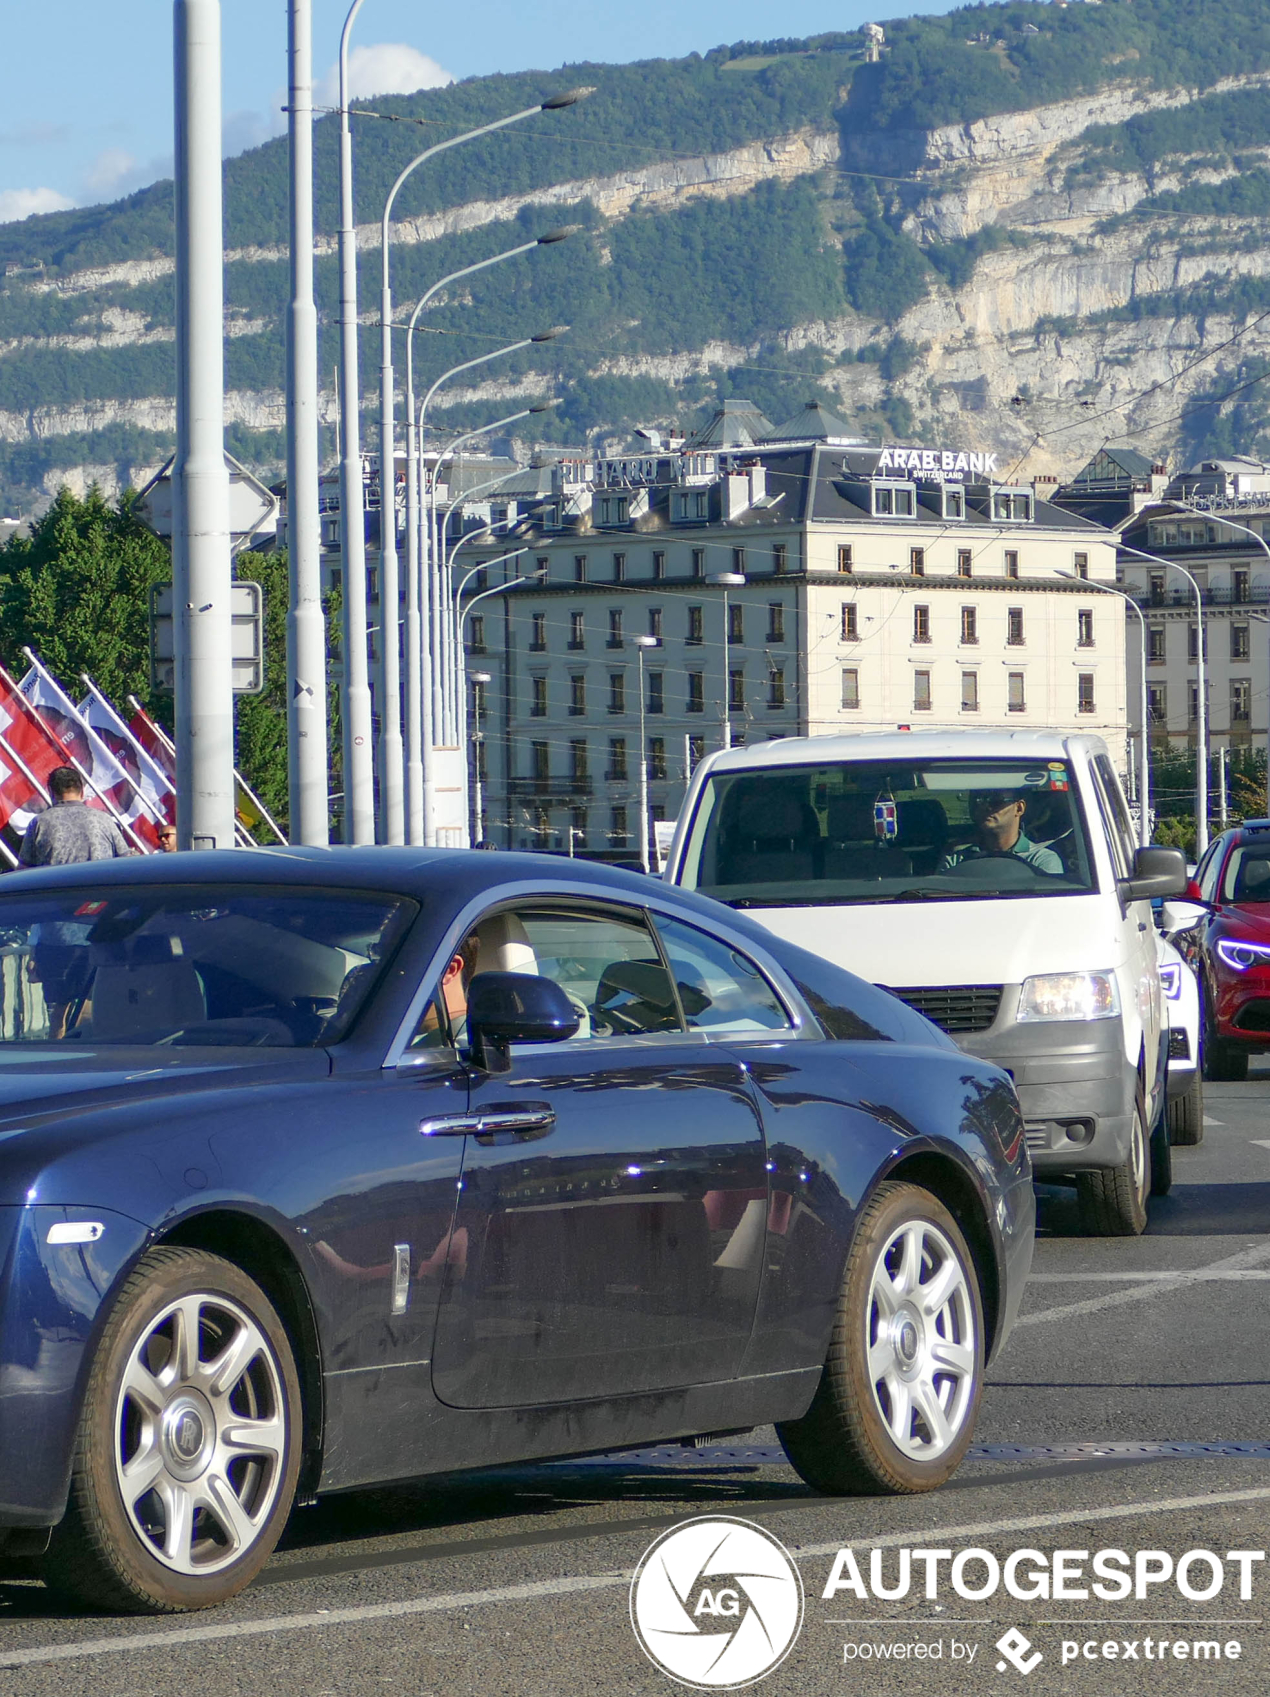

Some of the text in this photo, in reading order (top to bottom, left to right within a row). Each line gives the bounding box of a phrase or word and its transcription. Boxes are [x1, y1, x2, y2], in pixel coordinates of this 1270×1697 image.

[556, 457, 659, 486] RICHARD
[878, 448, 998, 472] ARAB BANK
[912, 469, 964, 480] SWITZERLAND
